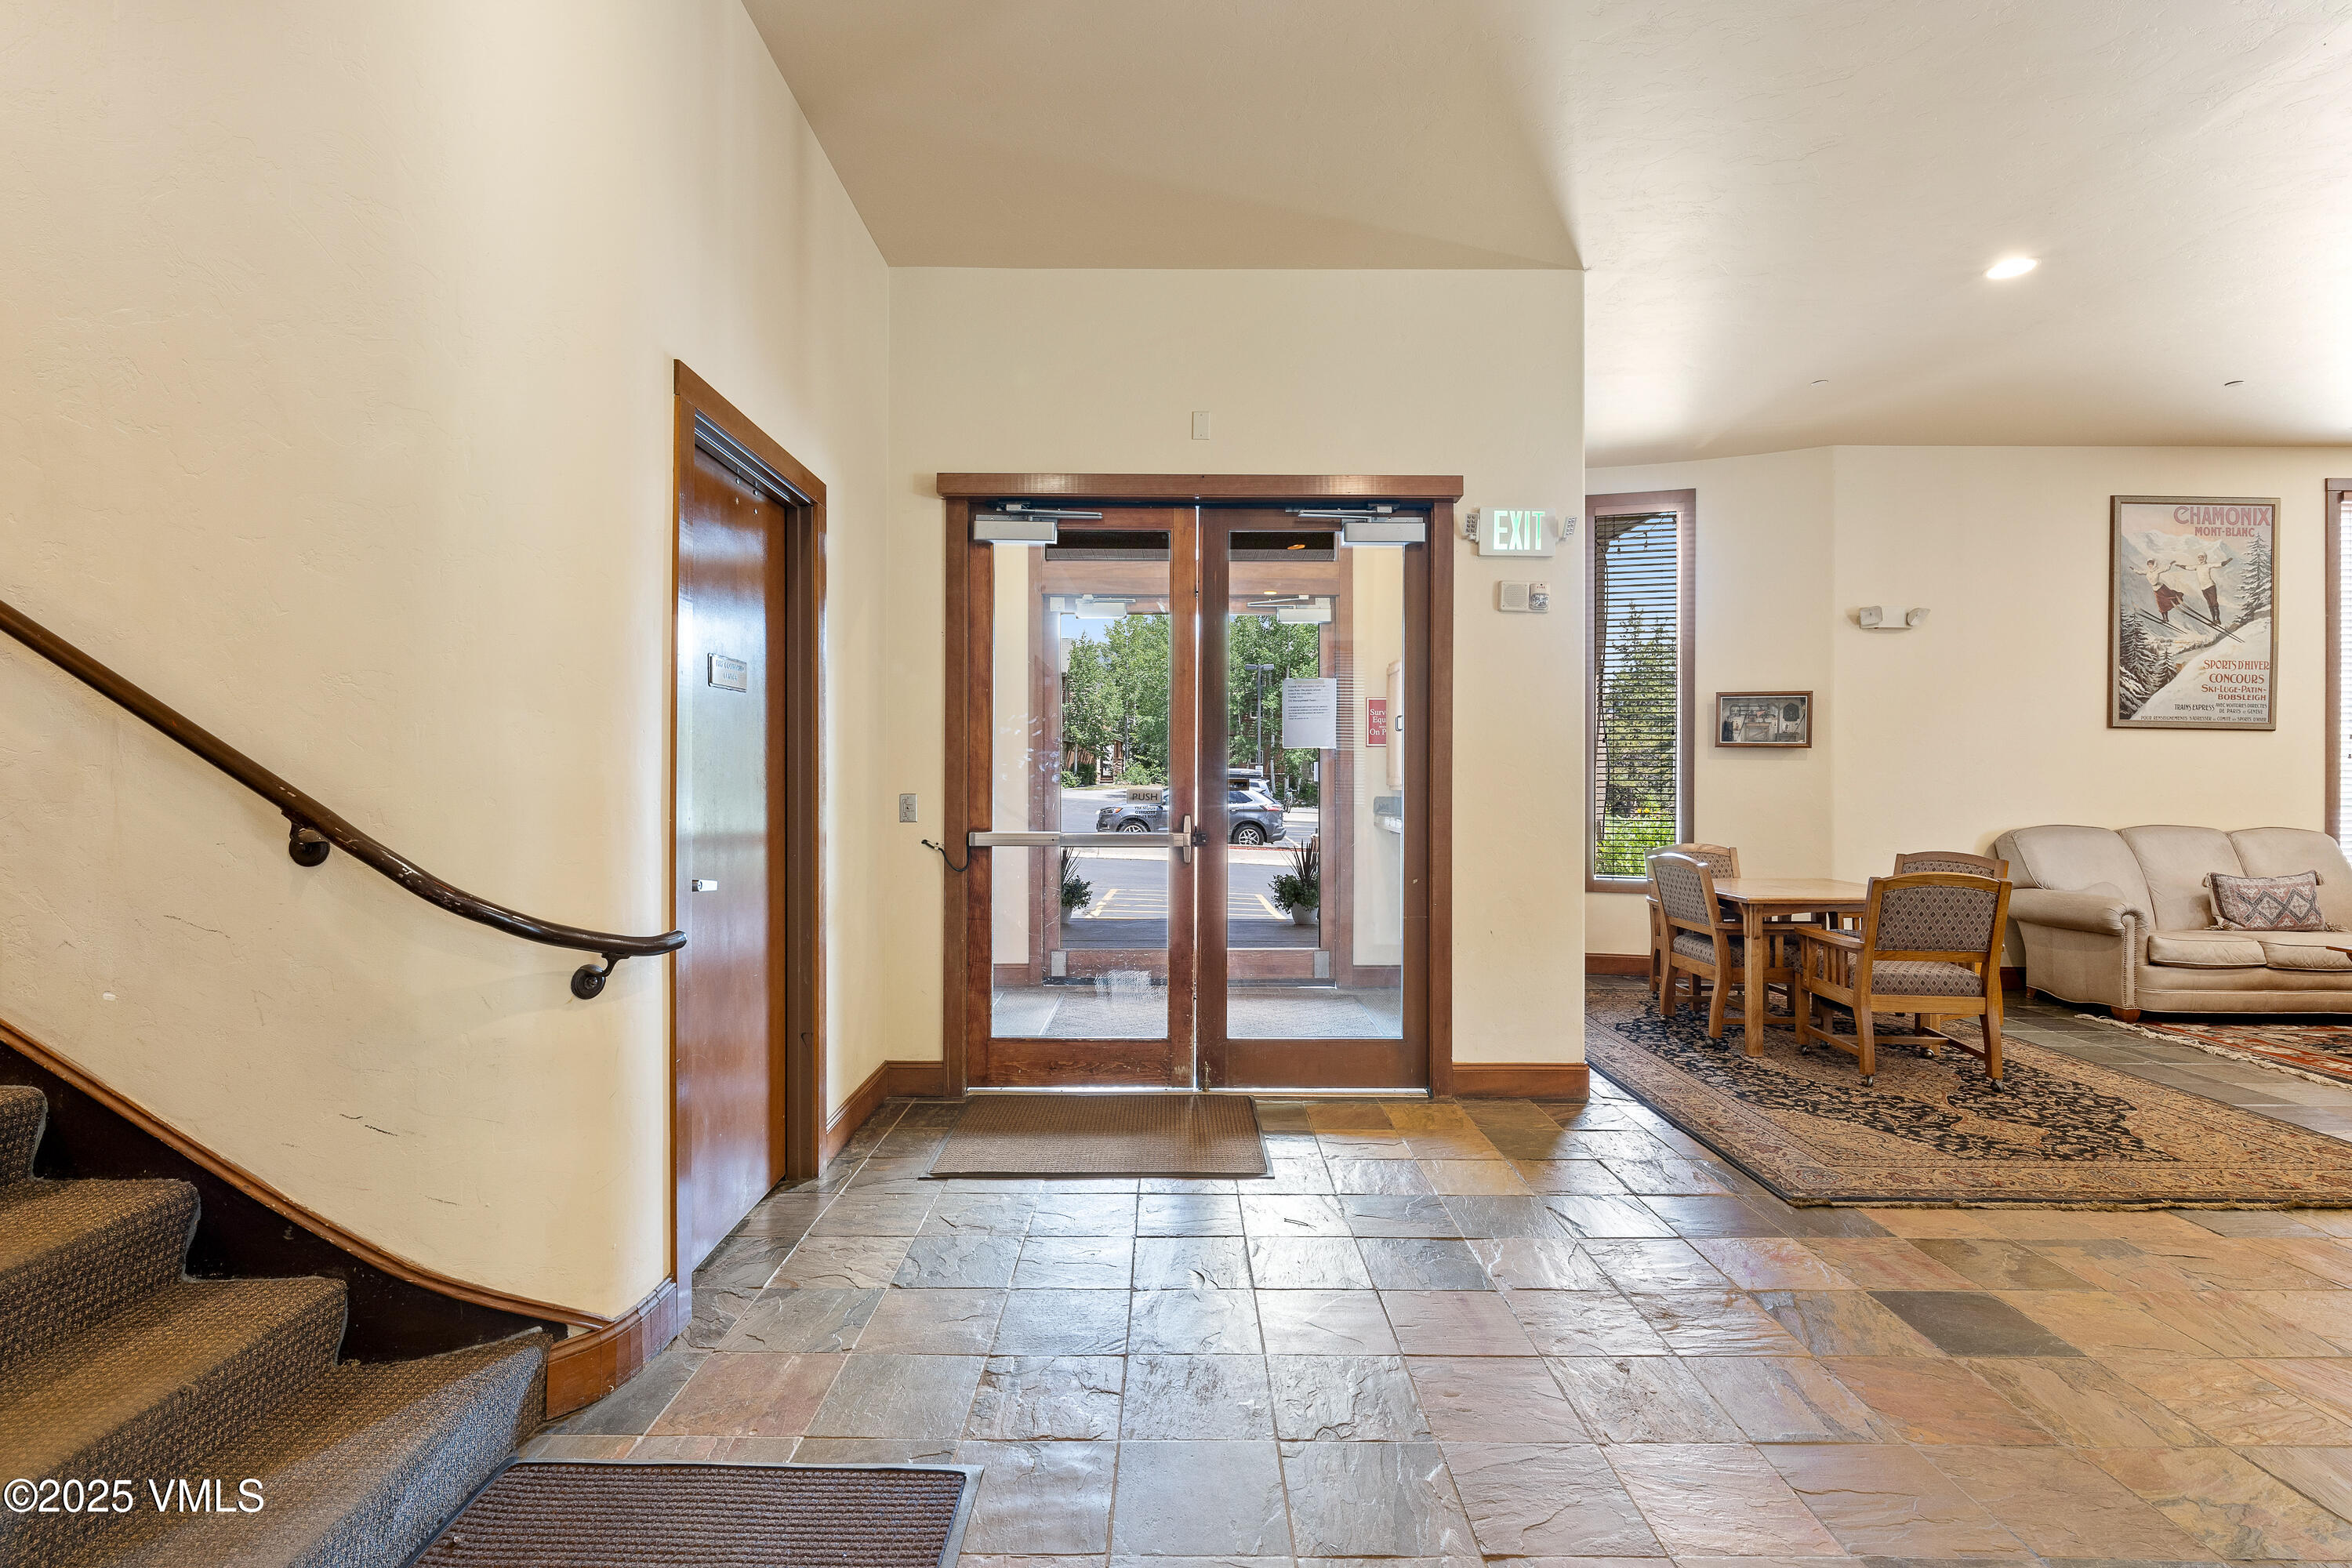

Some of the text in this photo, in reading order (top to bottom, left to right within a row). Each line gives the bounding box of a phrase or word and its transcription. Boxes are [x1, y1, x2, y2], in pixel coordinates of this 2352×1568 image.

[2173, 506, 2270, 526] CHAMONIX
[1494, 510, 1545, 550] EXIT
[2195, 527, 2256, 538] MONT-BLANC
[2204, 659, 2270, 671] SPORTS D'HIVER
[2209, 673, 2265, 684] CONCOURS
